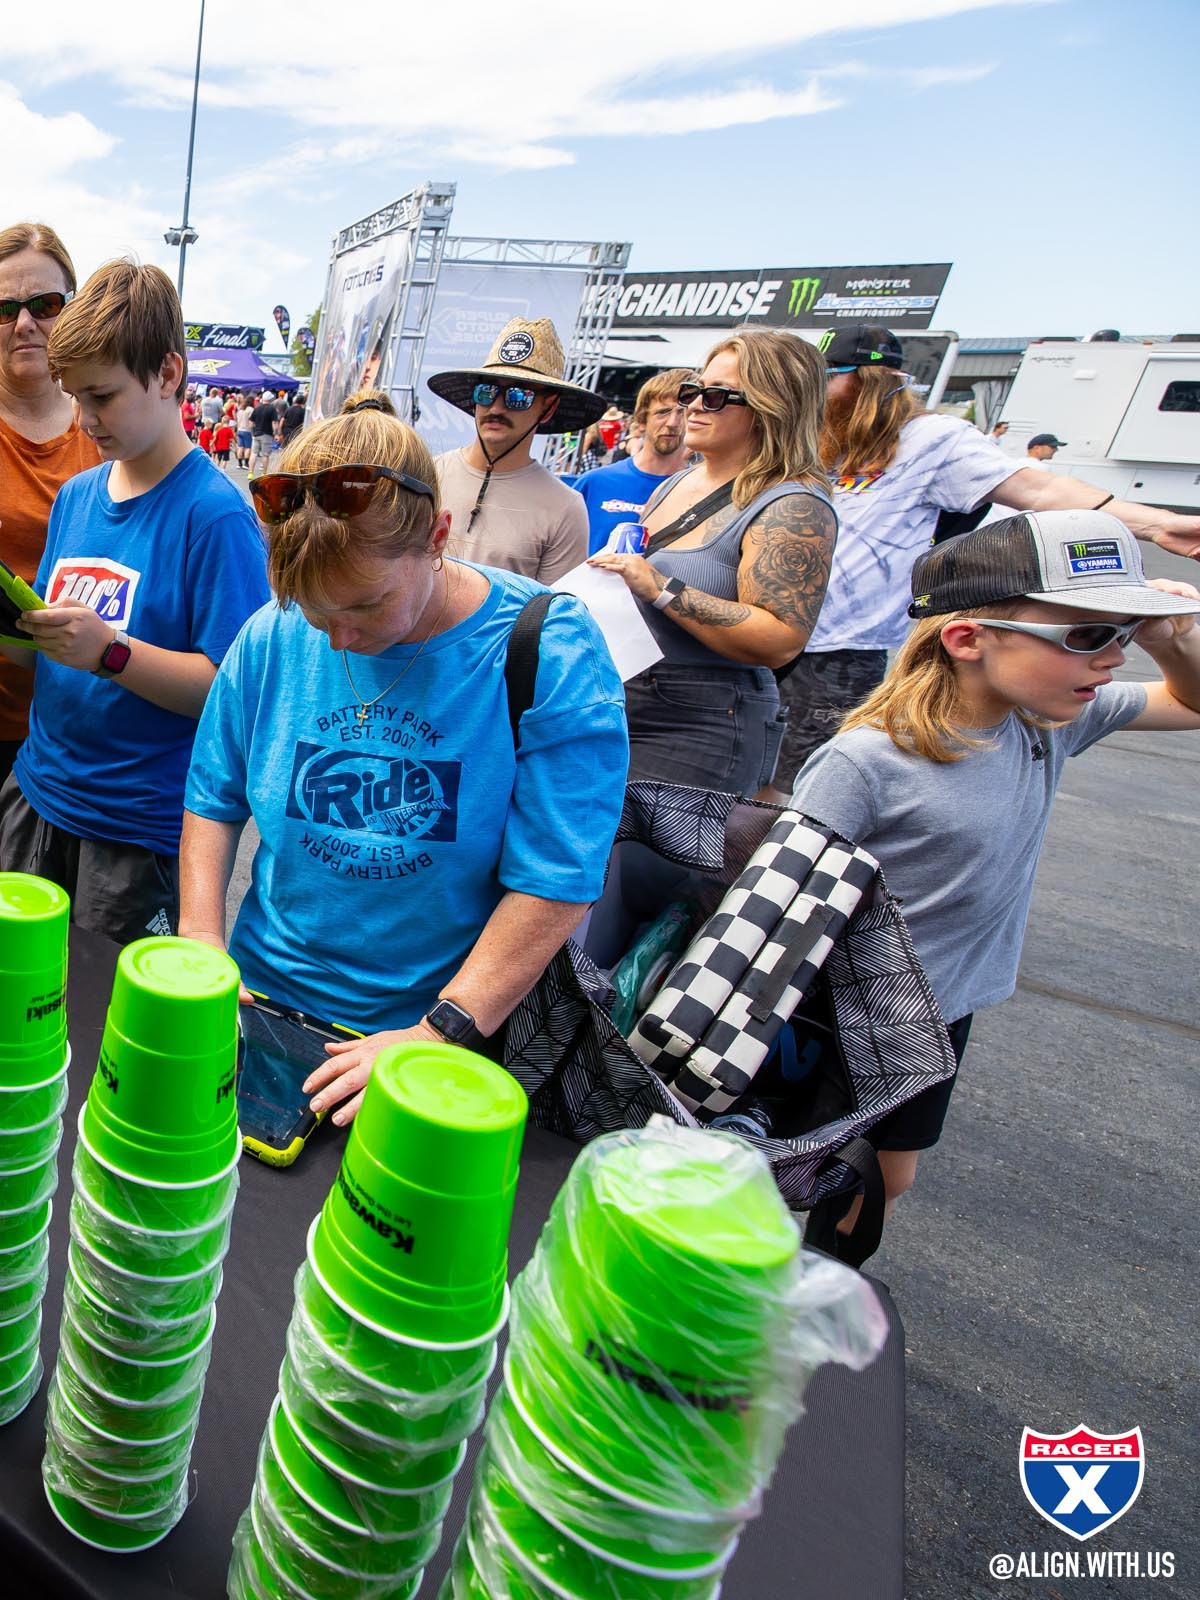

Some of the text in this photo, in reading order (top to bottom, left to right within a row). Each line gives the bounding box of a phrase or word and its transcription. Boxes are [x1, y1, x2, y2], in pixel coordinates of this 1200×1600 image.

[845, 279, 911, 290] MONSTER
[837, 309, 907, 318] CHAMPIONSHIP
[202, 325, 249, 347] Finals
[1086, 558, 1118, 567] YAMAHA
[58, 572, 126, 617] 100%
[316, 704, 445, 748] BATTERY PARK
[340, 725, 417, 751] EST. 2007
[306, 759, 434, 831] Ride
[419, 798, 451, 812] PARK
[299, 831, 434, 881] BATTERY PARK
[321, 834, 405, 863] EST. 2007
[159, 908, 171, 936] adidas
